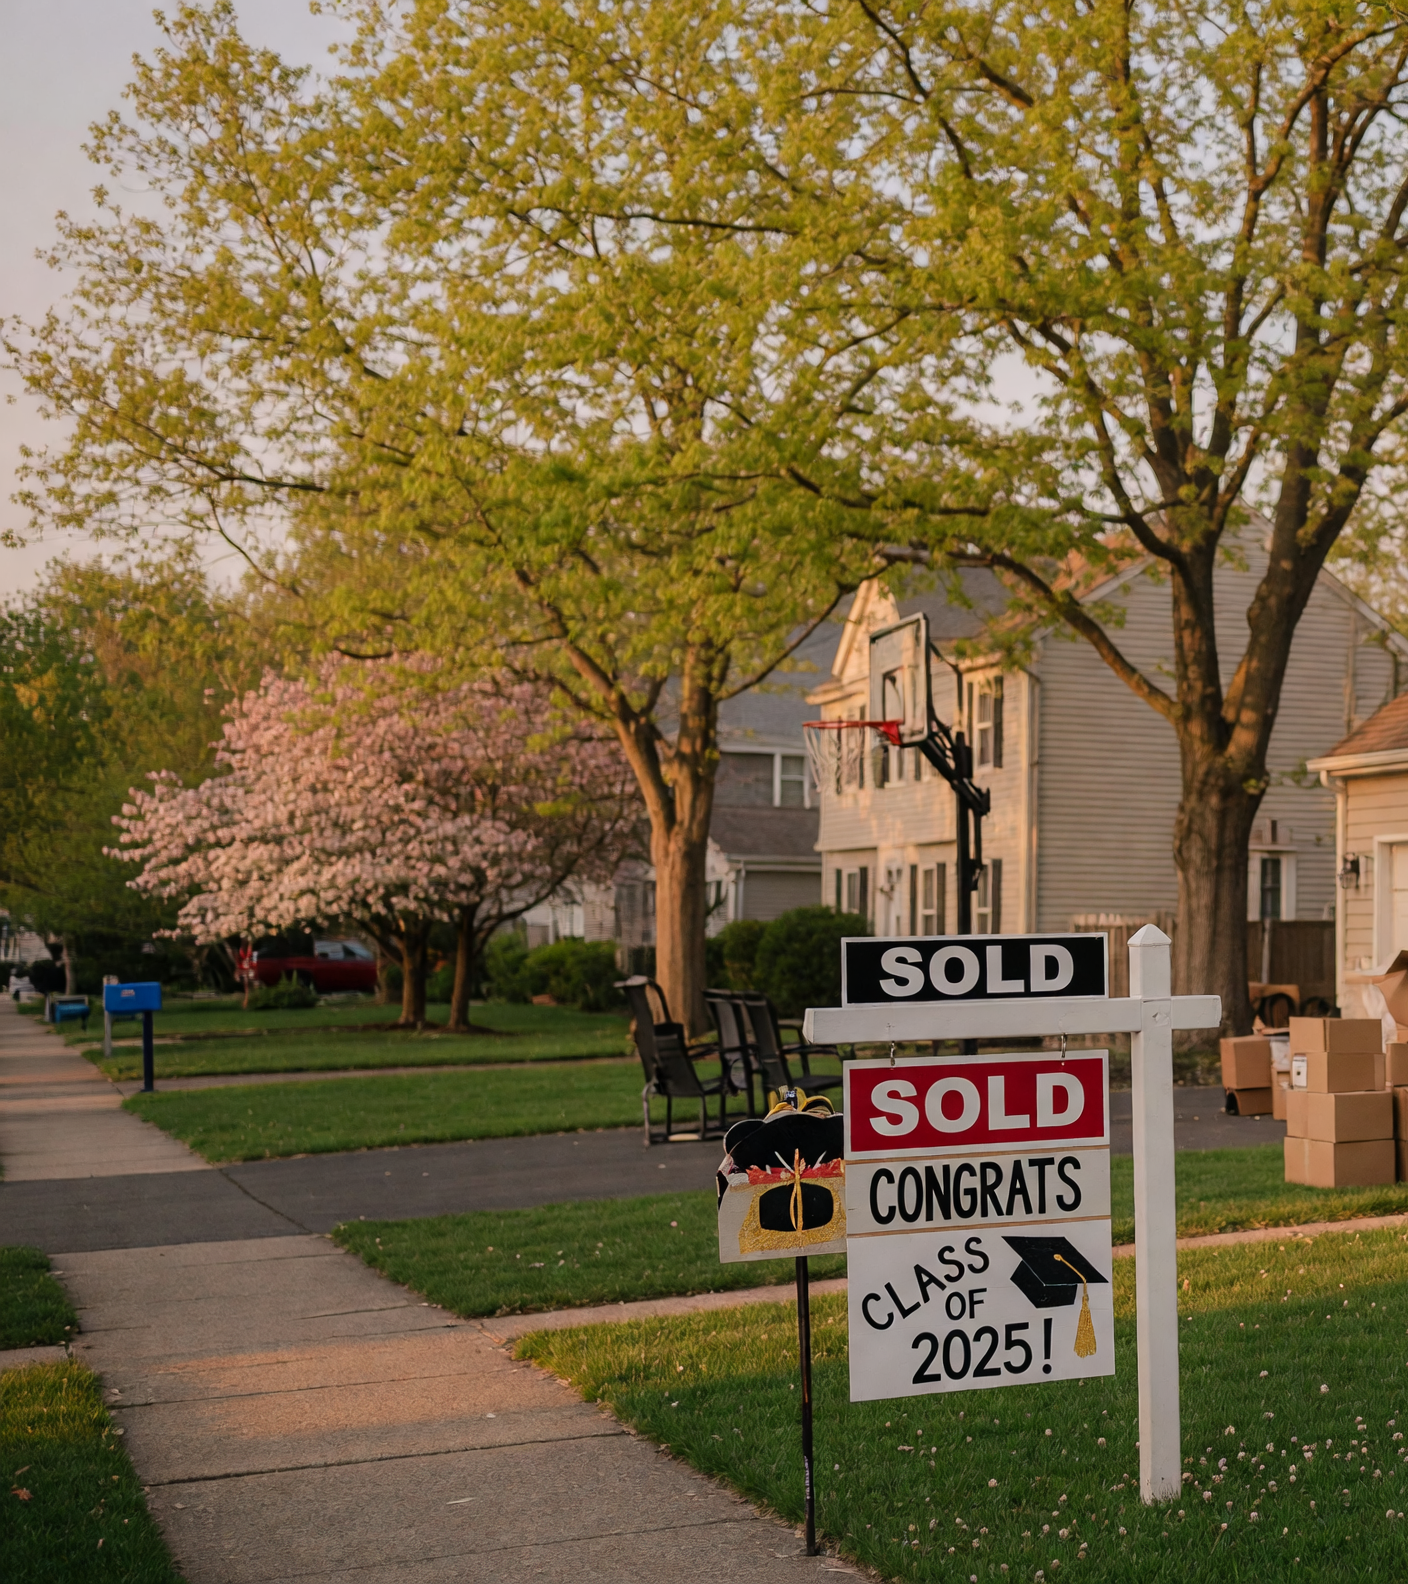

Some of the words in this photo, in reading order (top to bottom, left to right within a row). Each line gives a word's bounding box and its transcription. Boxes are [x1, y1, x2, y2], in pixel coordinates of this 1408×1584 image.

[879, 945, 1074, 997] SOLD
[869, 1072, 1085, 1137] SOLD
[869, 1155, 1082, 1225] CONGRATS
[861, 1236, 990, 1331] CLASS
[944, 1287, 988, 1321] OF
[911, 1317, 1053, 1385] 2025!
